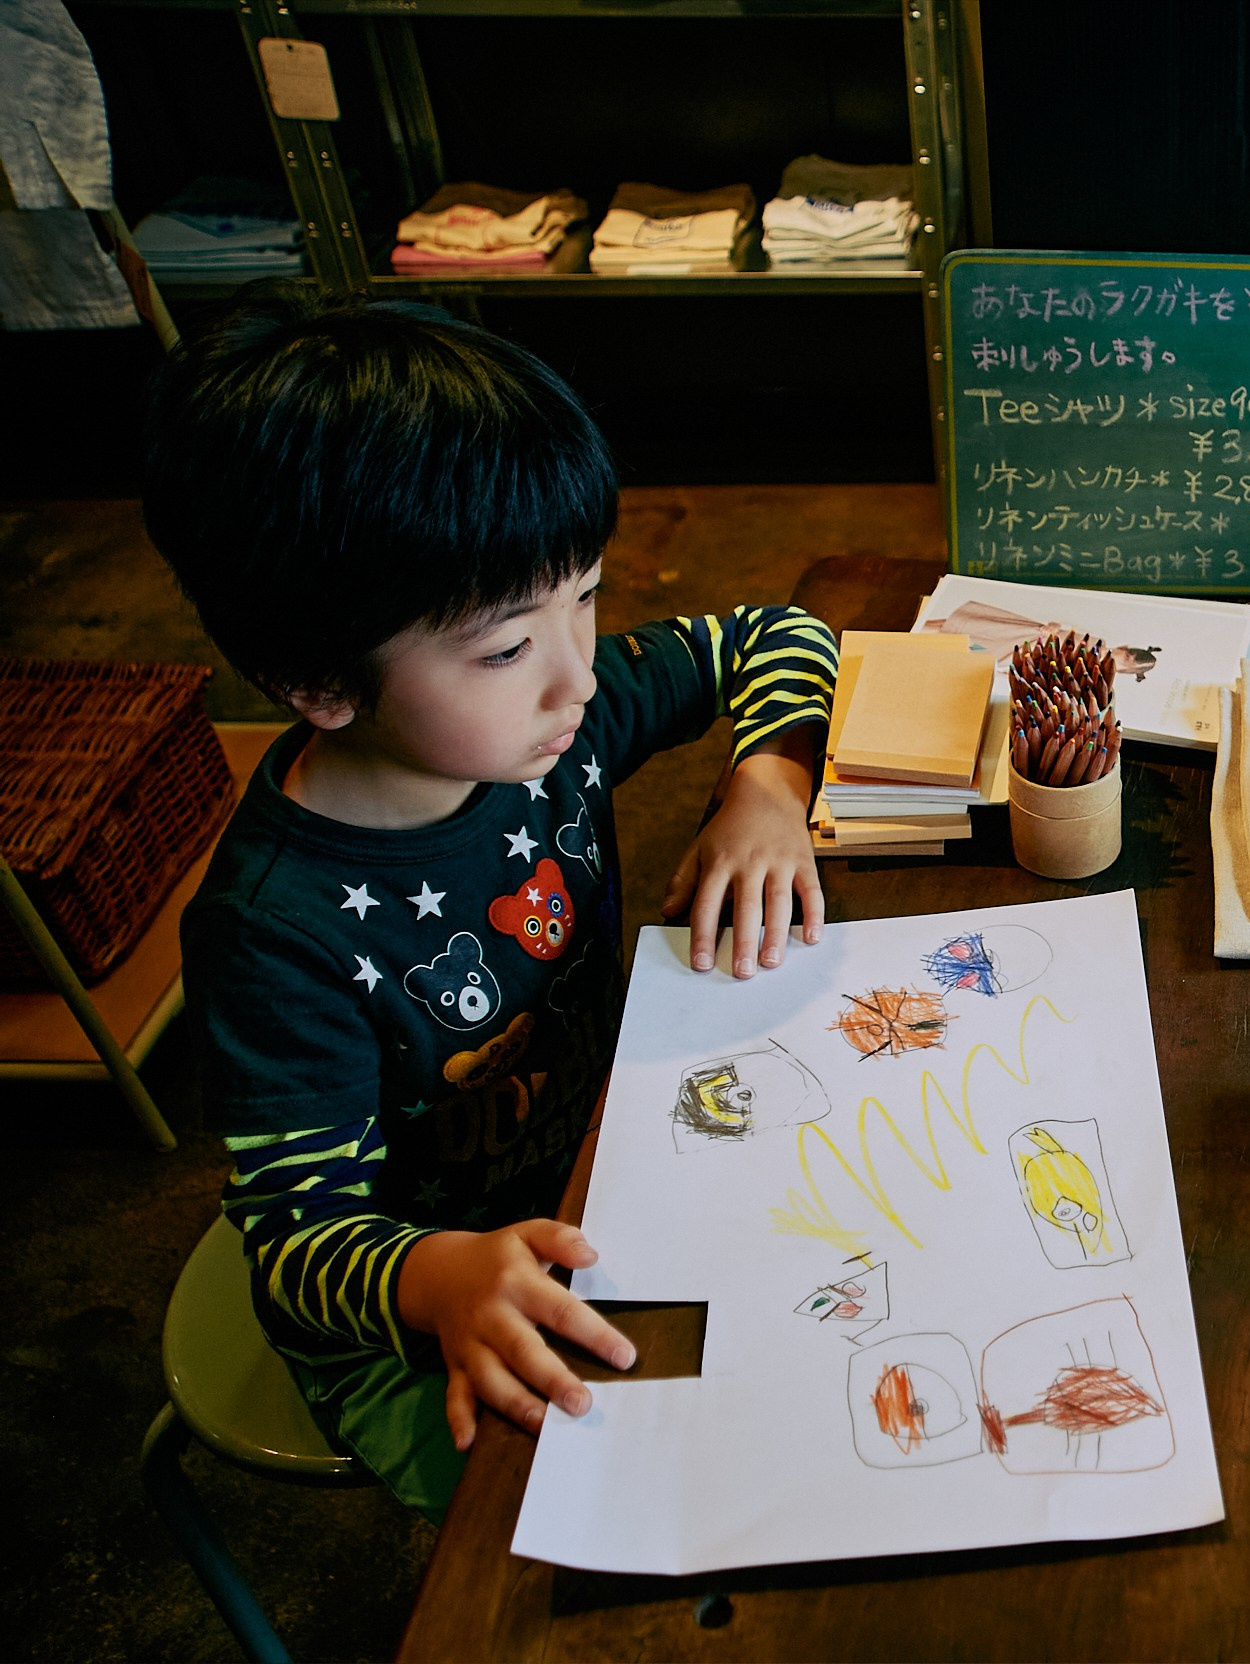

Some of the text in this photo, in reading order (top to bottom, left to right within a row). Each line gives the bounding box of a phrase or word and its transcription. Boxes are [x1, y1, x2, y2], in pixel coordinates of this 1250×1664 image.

[972, 336, 1176, 374] 刺しゅうします。
